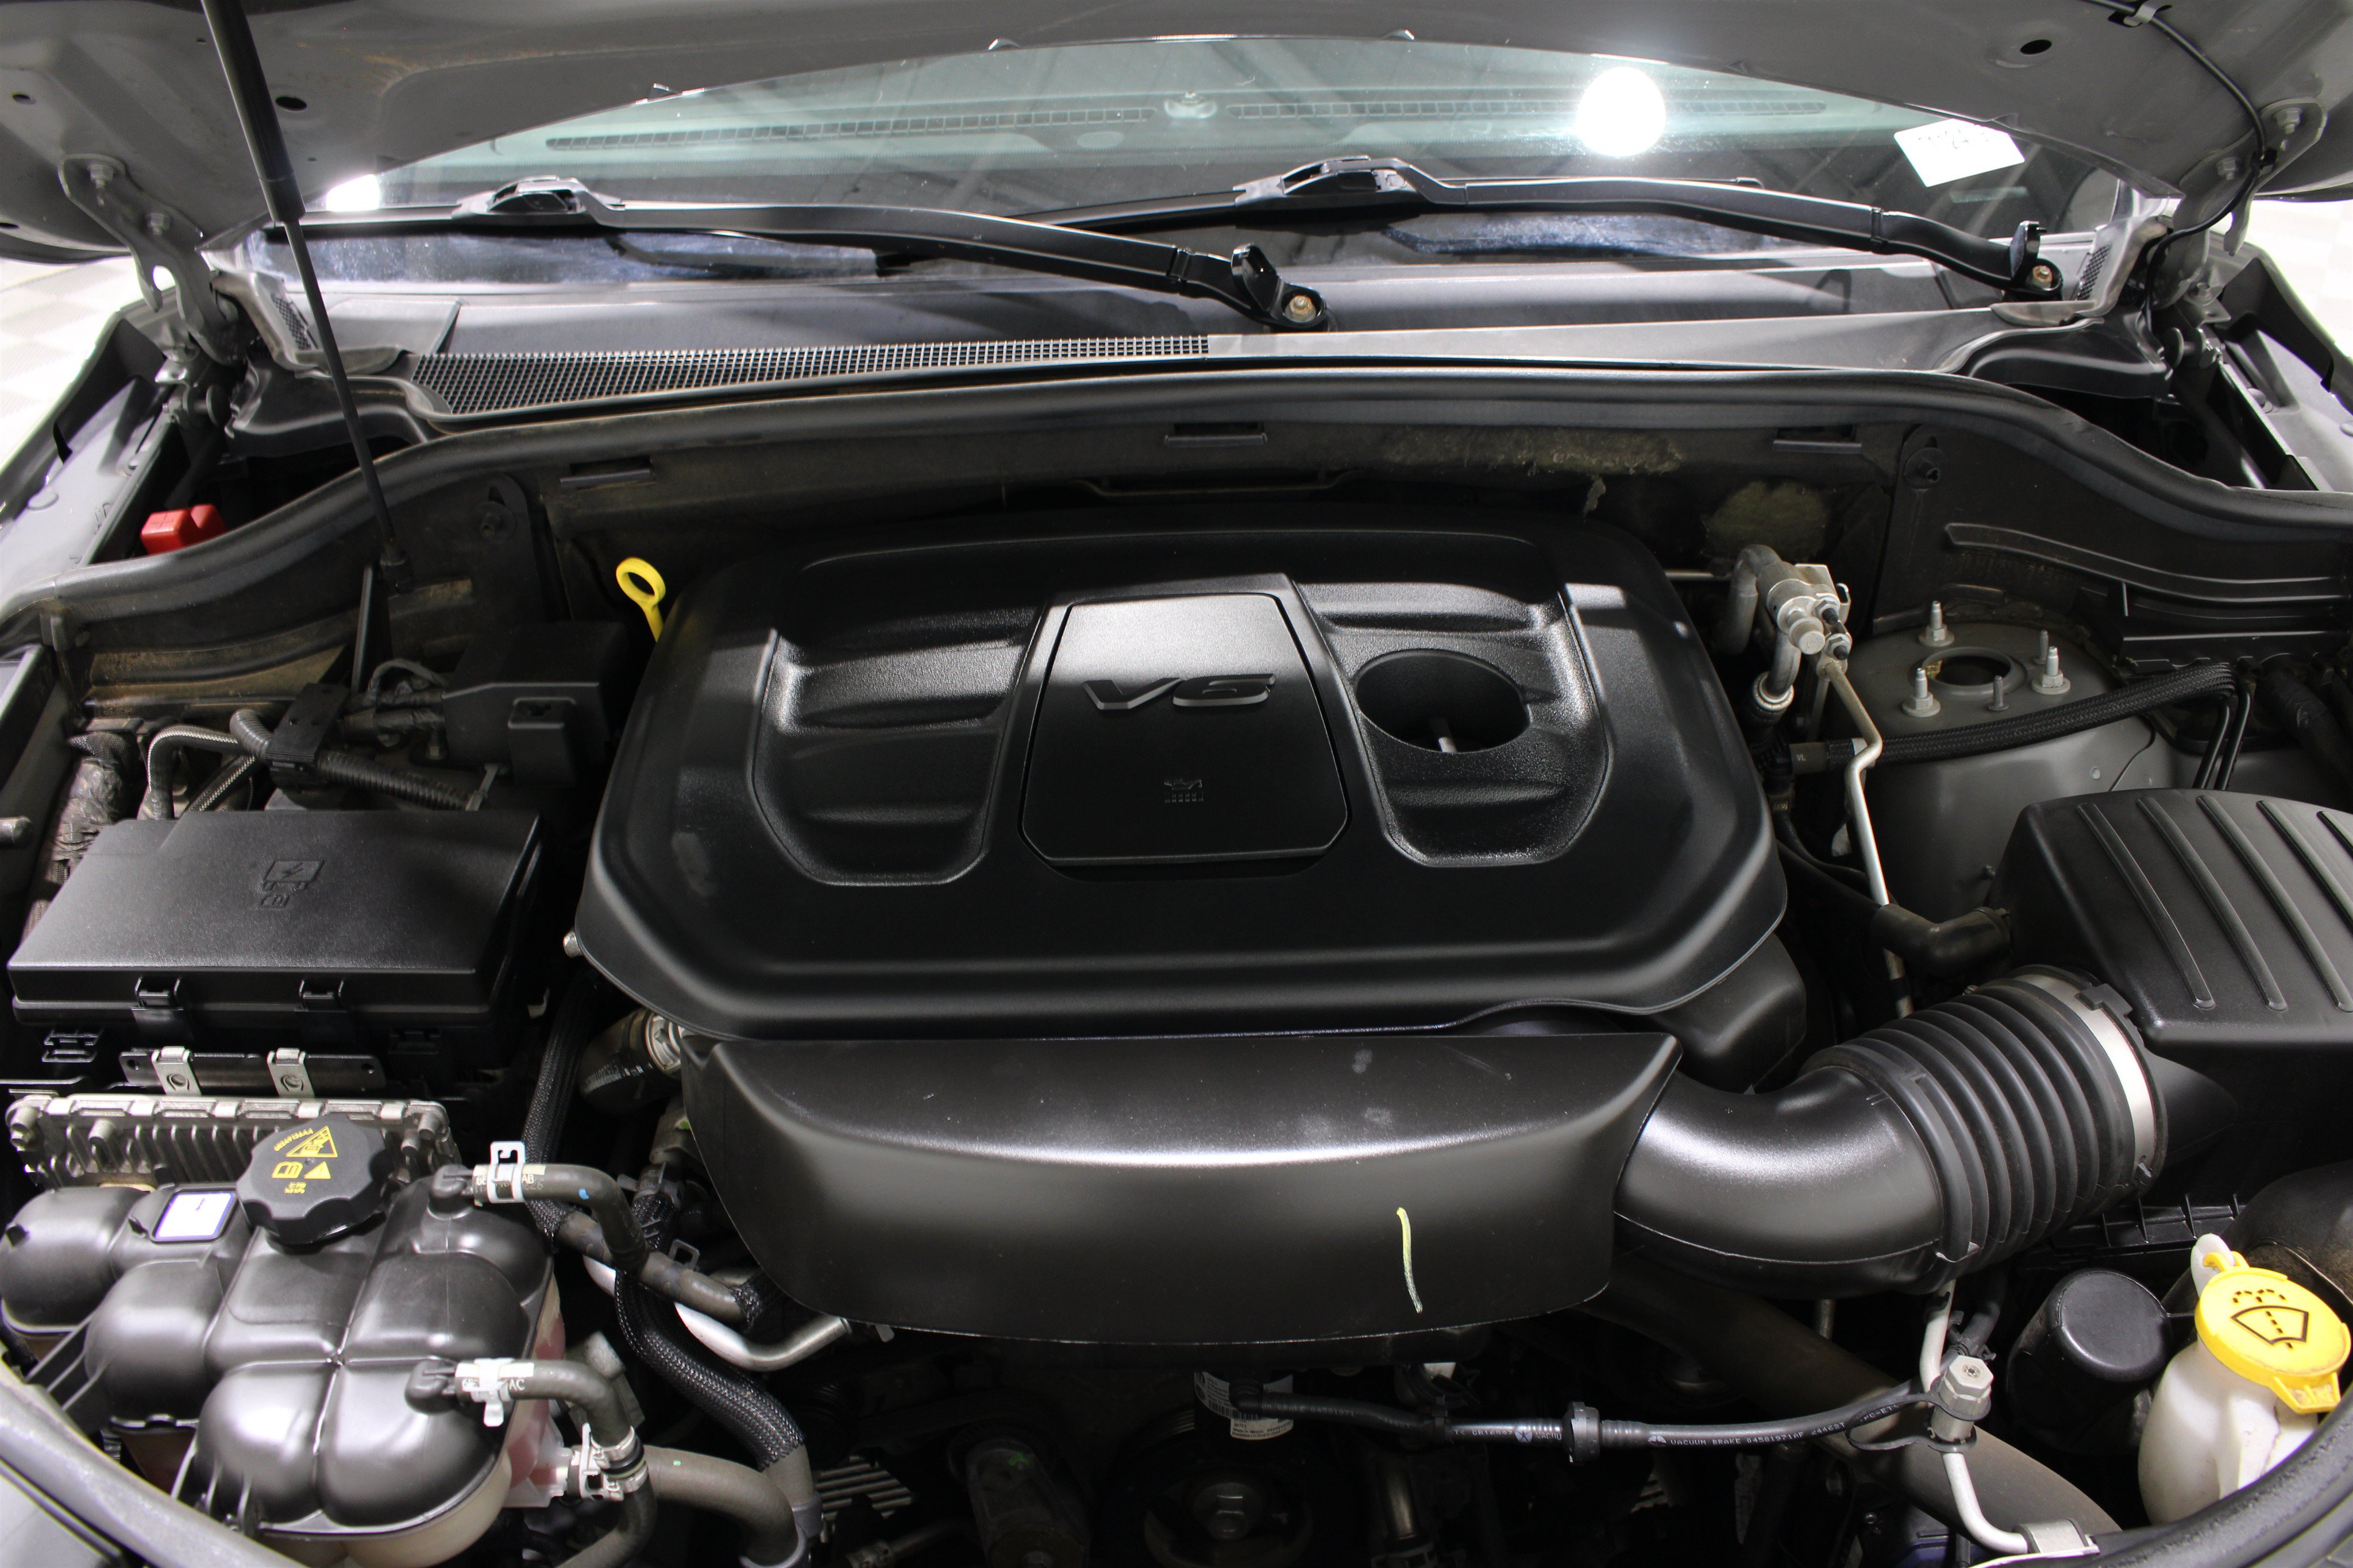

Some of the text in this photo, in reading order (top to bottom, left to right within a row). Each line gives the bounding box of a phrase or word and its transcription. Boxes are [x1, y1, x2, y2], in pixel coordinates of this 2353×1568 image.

[1083, 673, 1277, 710] V6
[1670, 1438, 1707, 1446] VACUUM
[1712, 1438, 1742, 1446] BRAKE
